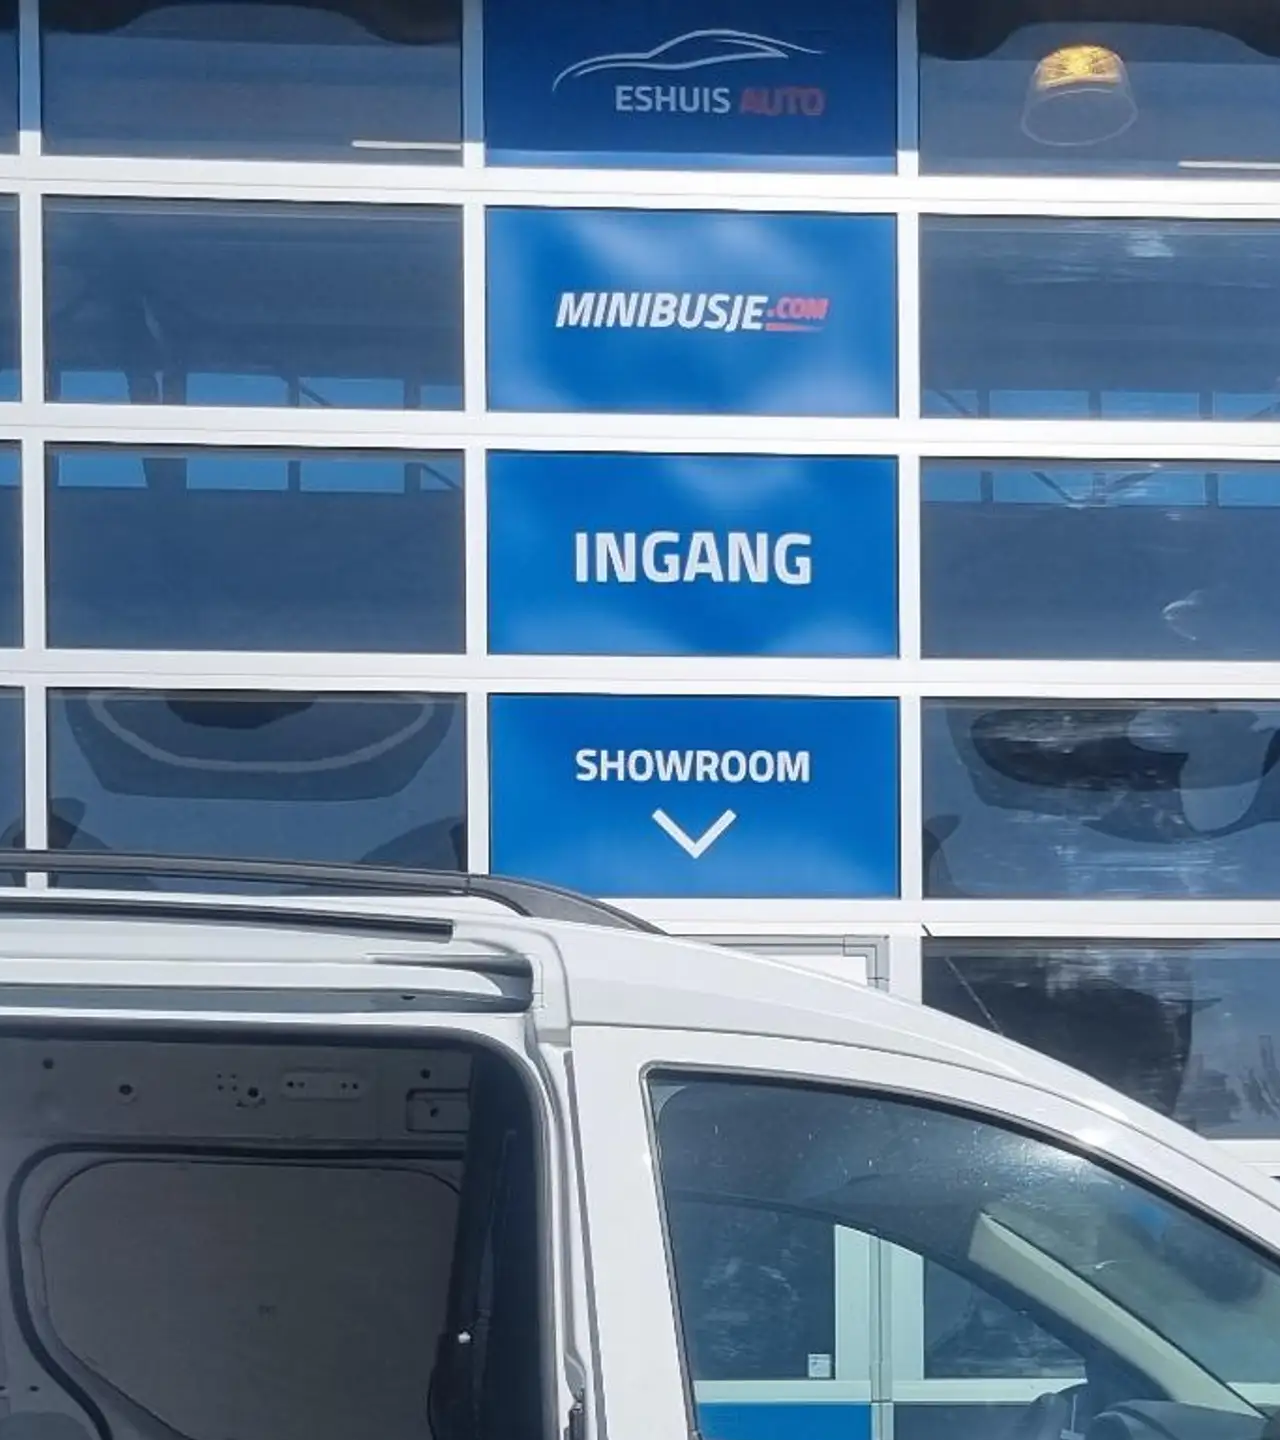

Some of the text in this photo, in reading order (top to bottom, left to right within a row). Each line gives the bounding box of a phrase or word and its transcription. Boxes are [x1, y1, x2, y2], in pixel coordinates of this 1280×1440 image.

[615, 85, 826, 116] ESHUIS AUTO
[575, 532, 812, 585] INGANG
[575, 749, 810, 783] SHOWROOM
